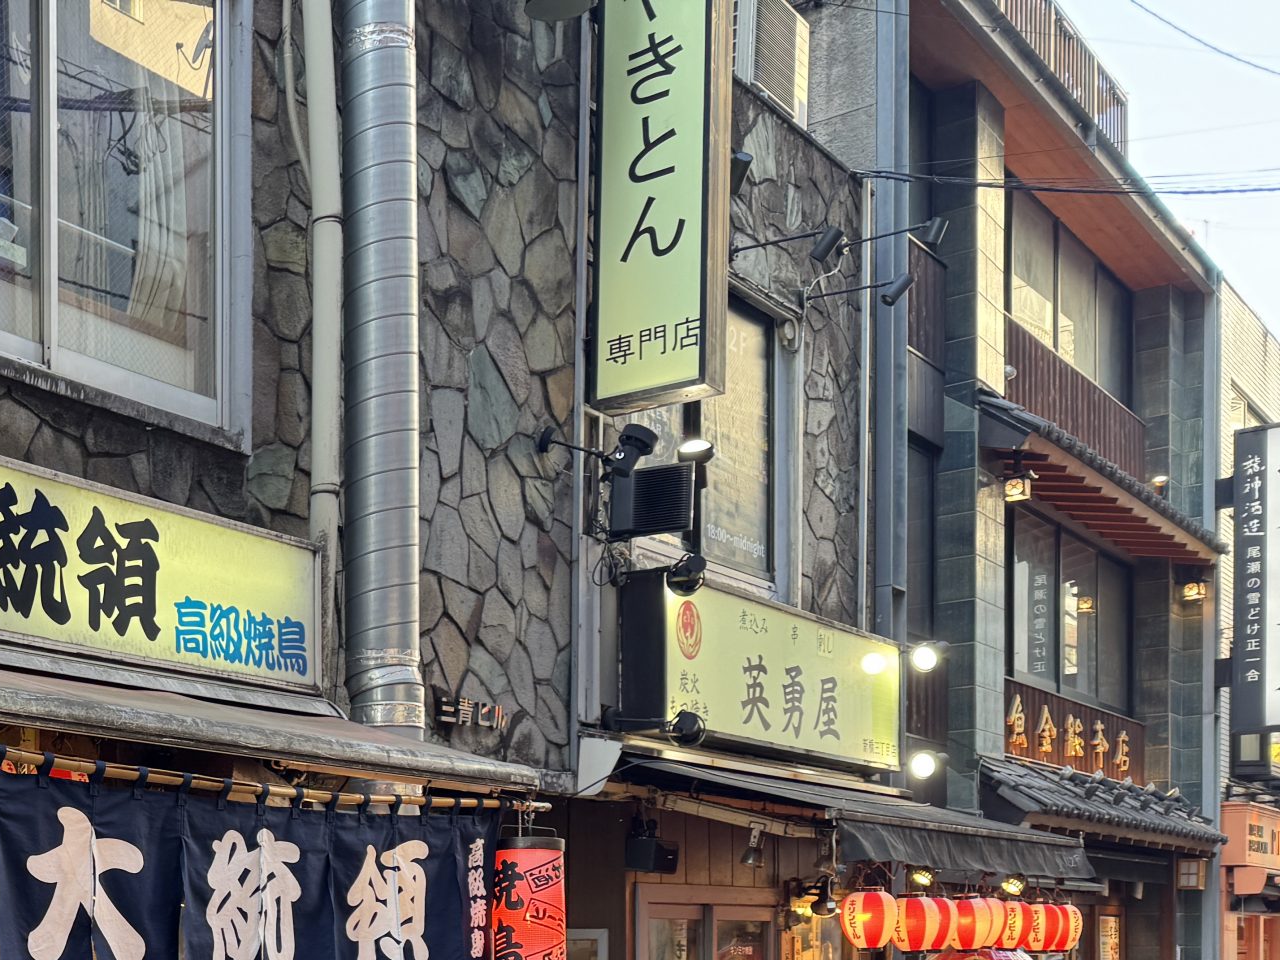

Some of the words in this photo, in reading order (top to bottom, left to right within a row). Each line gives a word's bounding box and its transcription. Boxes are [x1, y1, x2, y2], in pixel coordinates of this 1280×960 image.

[621, 0, 685, 263] きとん
[606, 317, 700, 365] 専門店
[175, 595, 308, 678] 高級焼鳥
[848, 900, 861, 940] キリンビール
